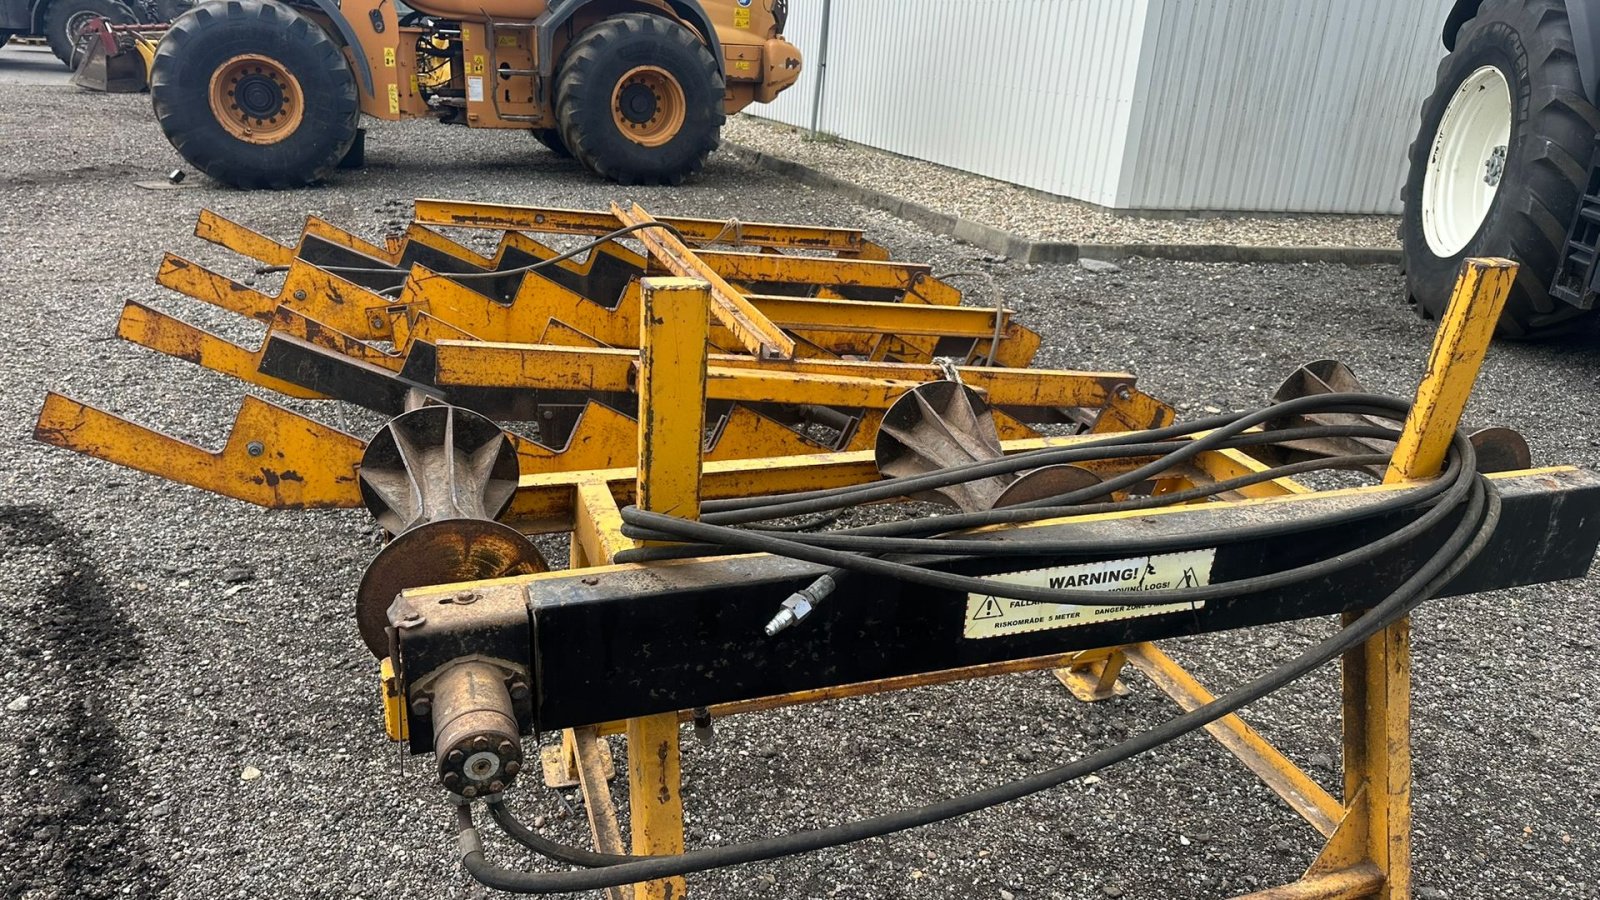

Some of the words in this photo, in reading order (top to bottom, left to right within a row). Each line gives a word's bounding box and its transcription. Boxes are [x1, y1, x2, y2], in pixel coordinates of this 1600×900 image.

[1049, 567, 1139, 589] WARNING!
[1144, 582, 1171, 591] LOGS!
[1094, 604, 1125, 615] DANGER
[994, 616, 1045, 629] RISKOMRÅDE
[1054, 612, 1081, 621] METER
